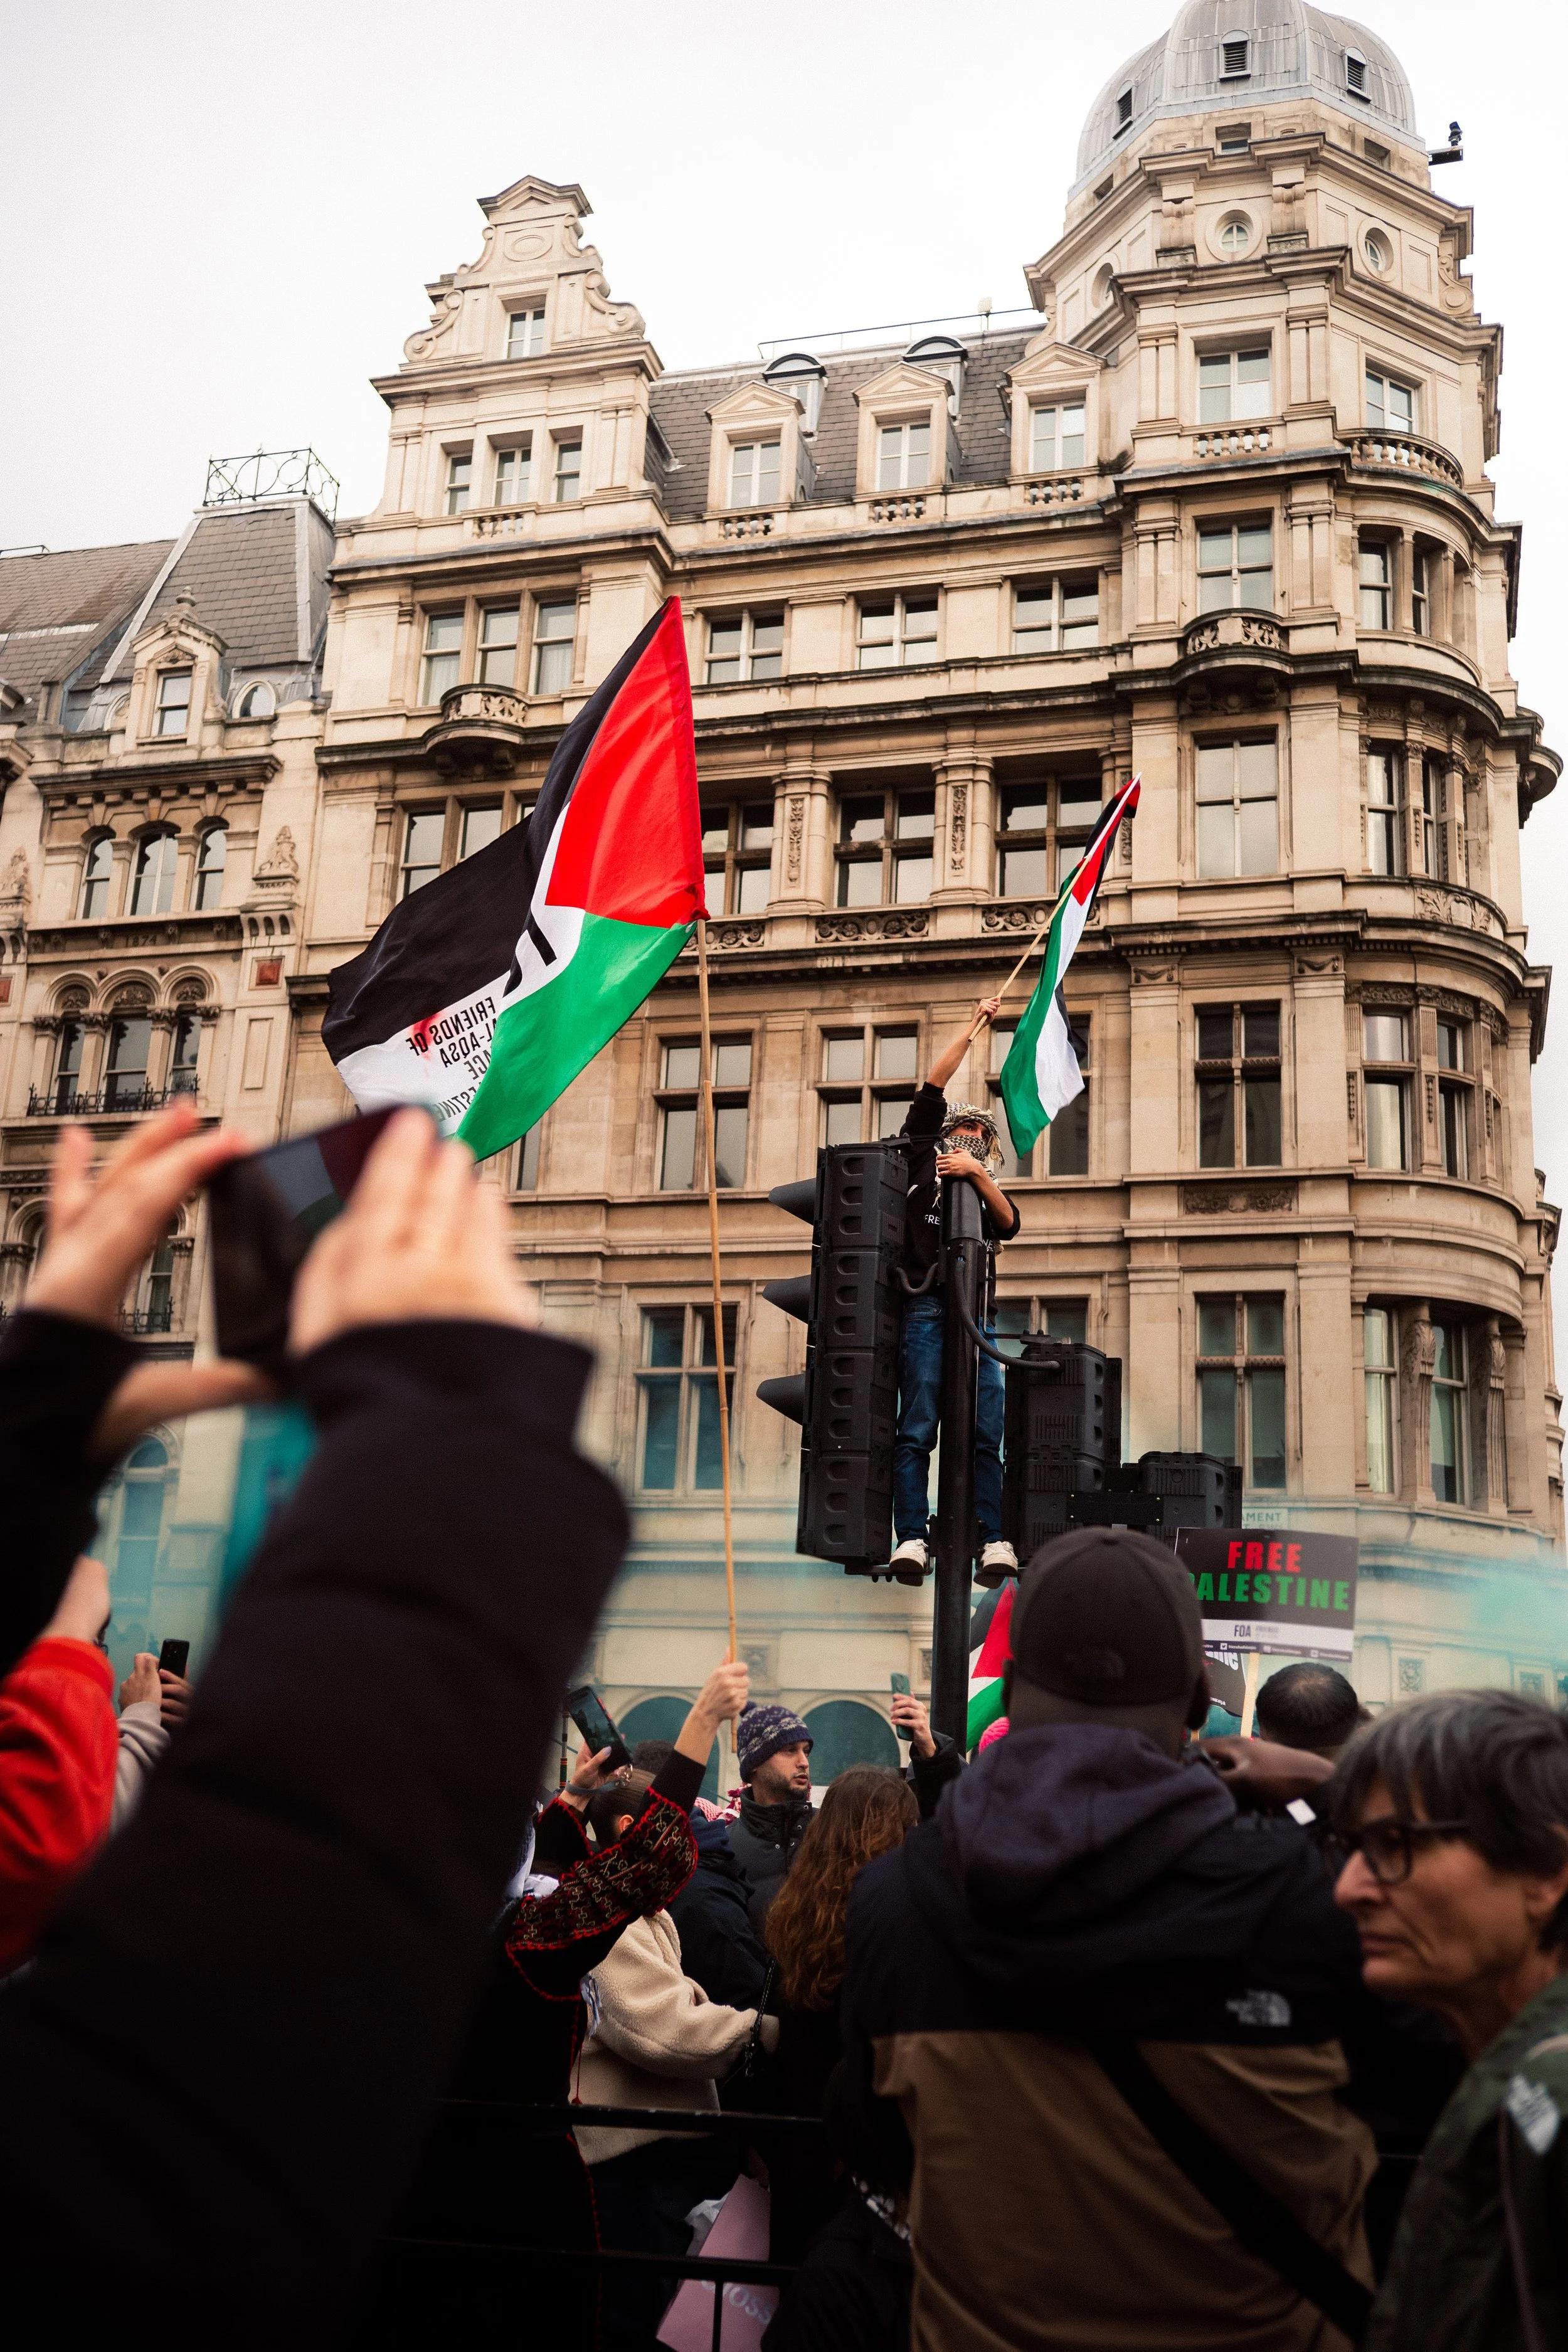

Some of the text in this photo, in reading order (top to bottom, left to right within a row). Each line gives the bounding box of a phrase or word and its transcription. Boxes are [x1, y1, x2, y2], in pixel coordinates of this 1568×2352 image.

[1242, 1512, 1281, 1522] MENT
[1227, 1541, 1302, 1573] FREE
[1234, 1624, 1251, 1638] FOA
